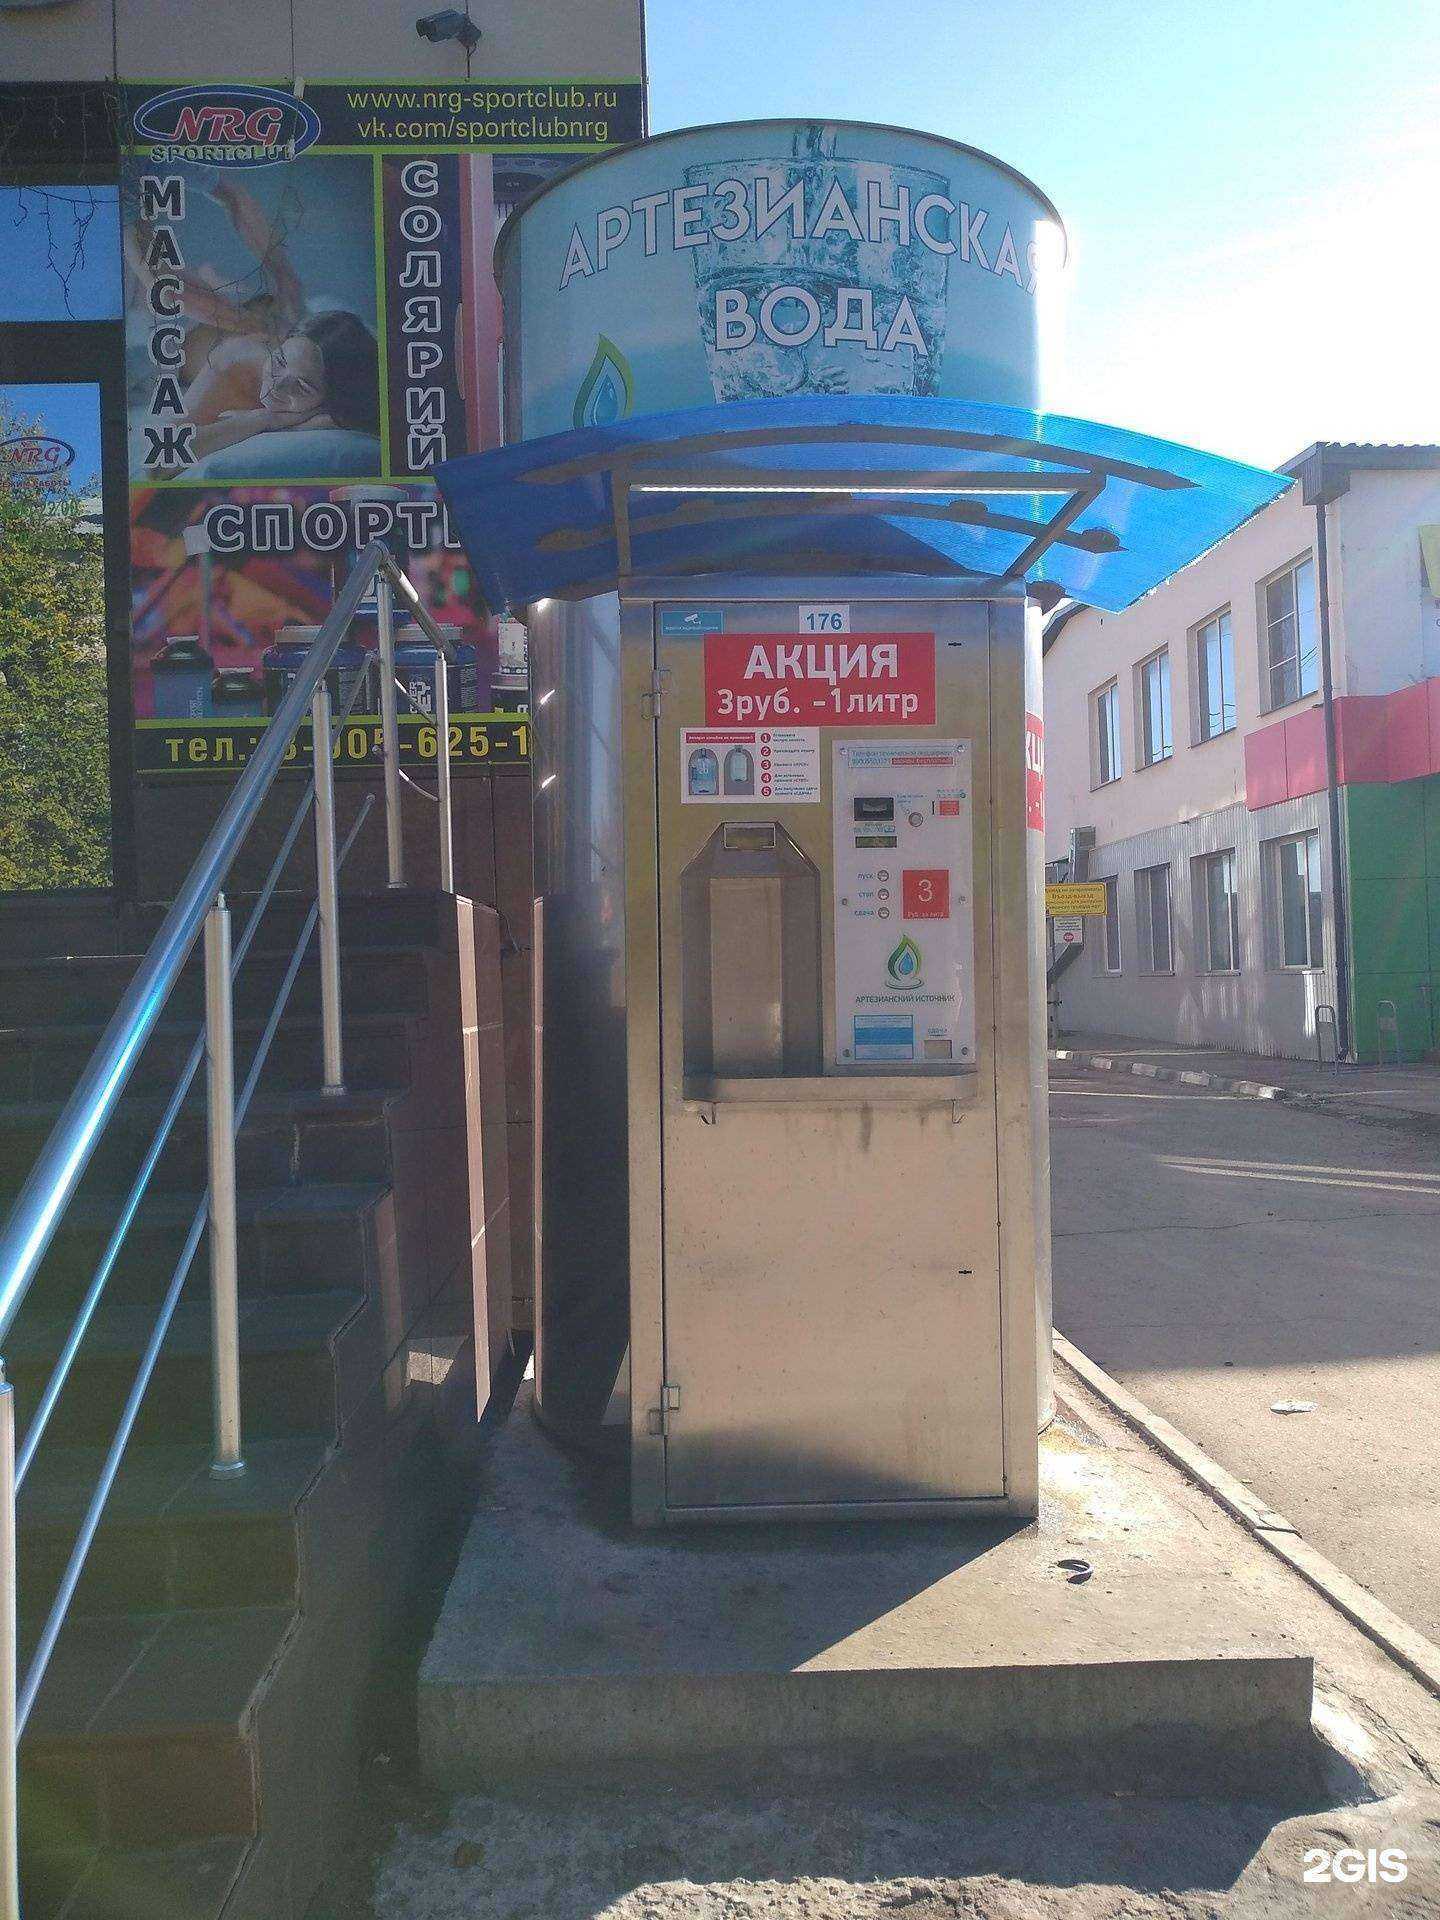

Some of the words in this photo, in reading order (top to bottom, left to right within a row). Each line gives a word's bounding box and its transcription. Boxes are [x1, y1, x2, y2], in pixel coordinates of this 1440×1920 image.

[346, 89, 618, 113] www.nrg-sportclub.ru
[174, 107, 284, 146] NRG
[357, 117, 609, 143] vk.com/sportclubnrg
[139, 175, 199, 469] МАССАЖ
[399, 160, 447, 472] СОЛЯРИЙ
[714, 286, 929, 355] ВОДА
[206, 502, 461, 552] СПОРТ
[806, 612, 843, 631] 176
[744, 643, 898, 685] АКЦИЯ
[717, 688, 801, 722] 3руб.
[918, 878, 933, 902] 3
